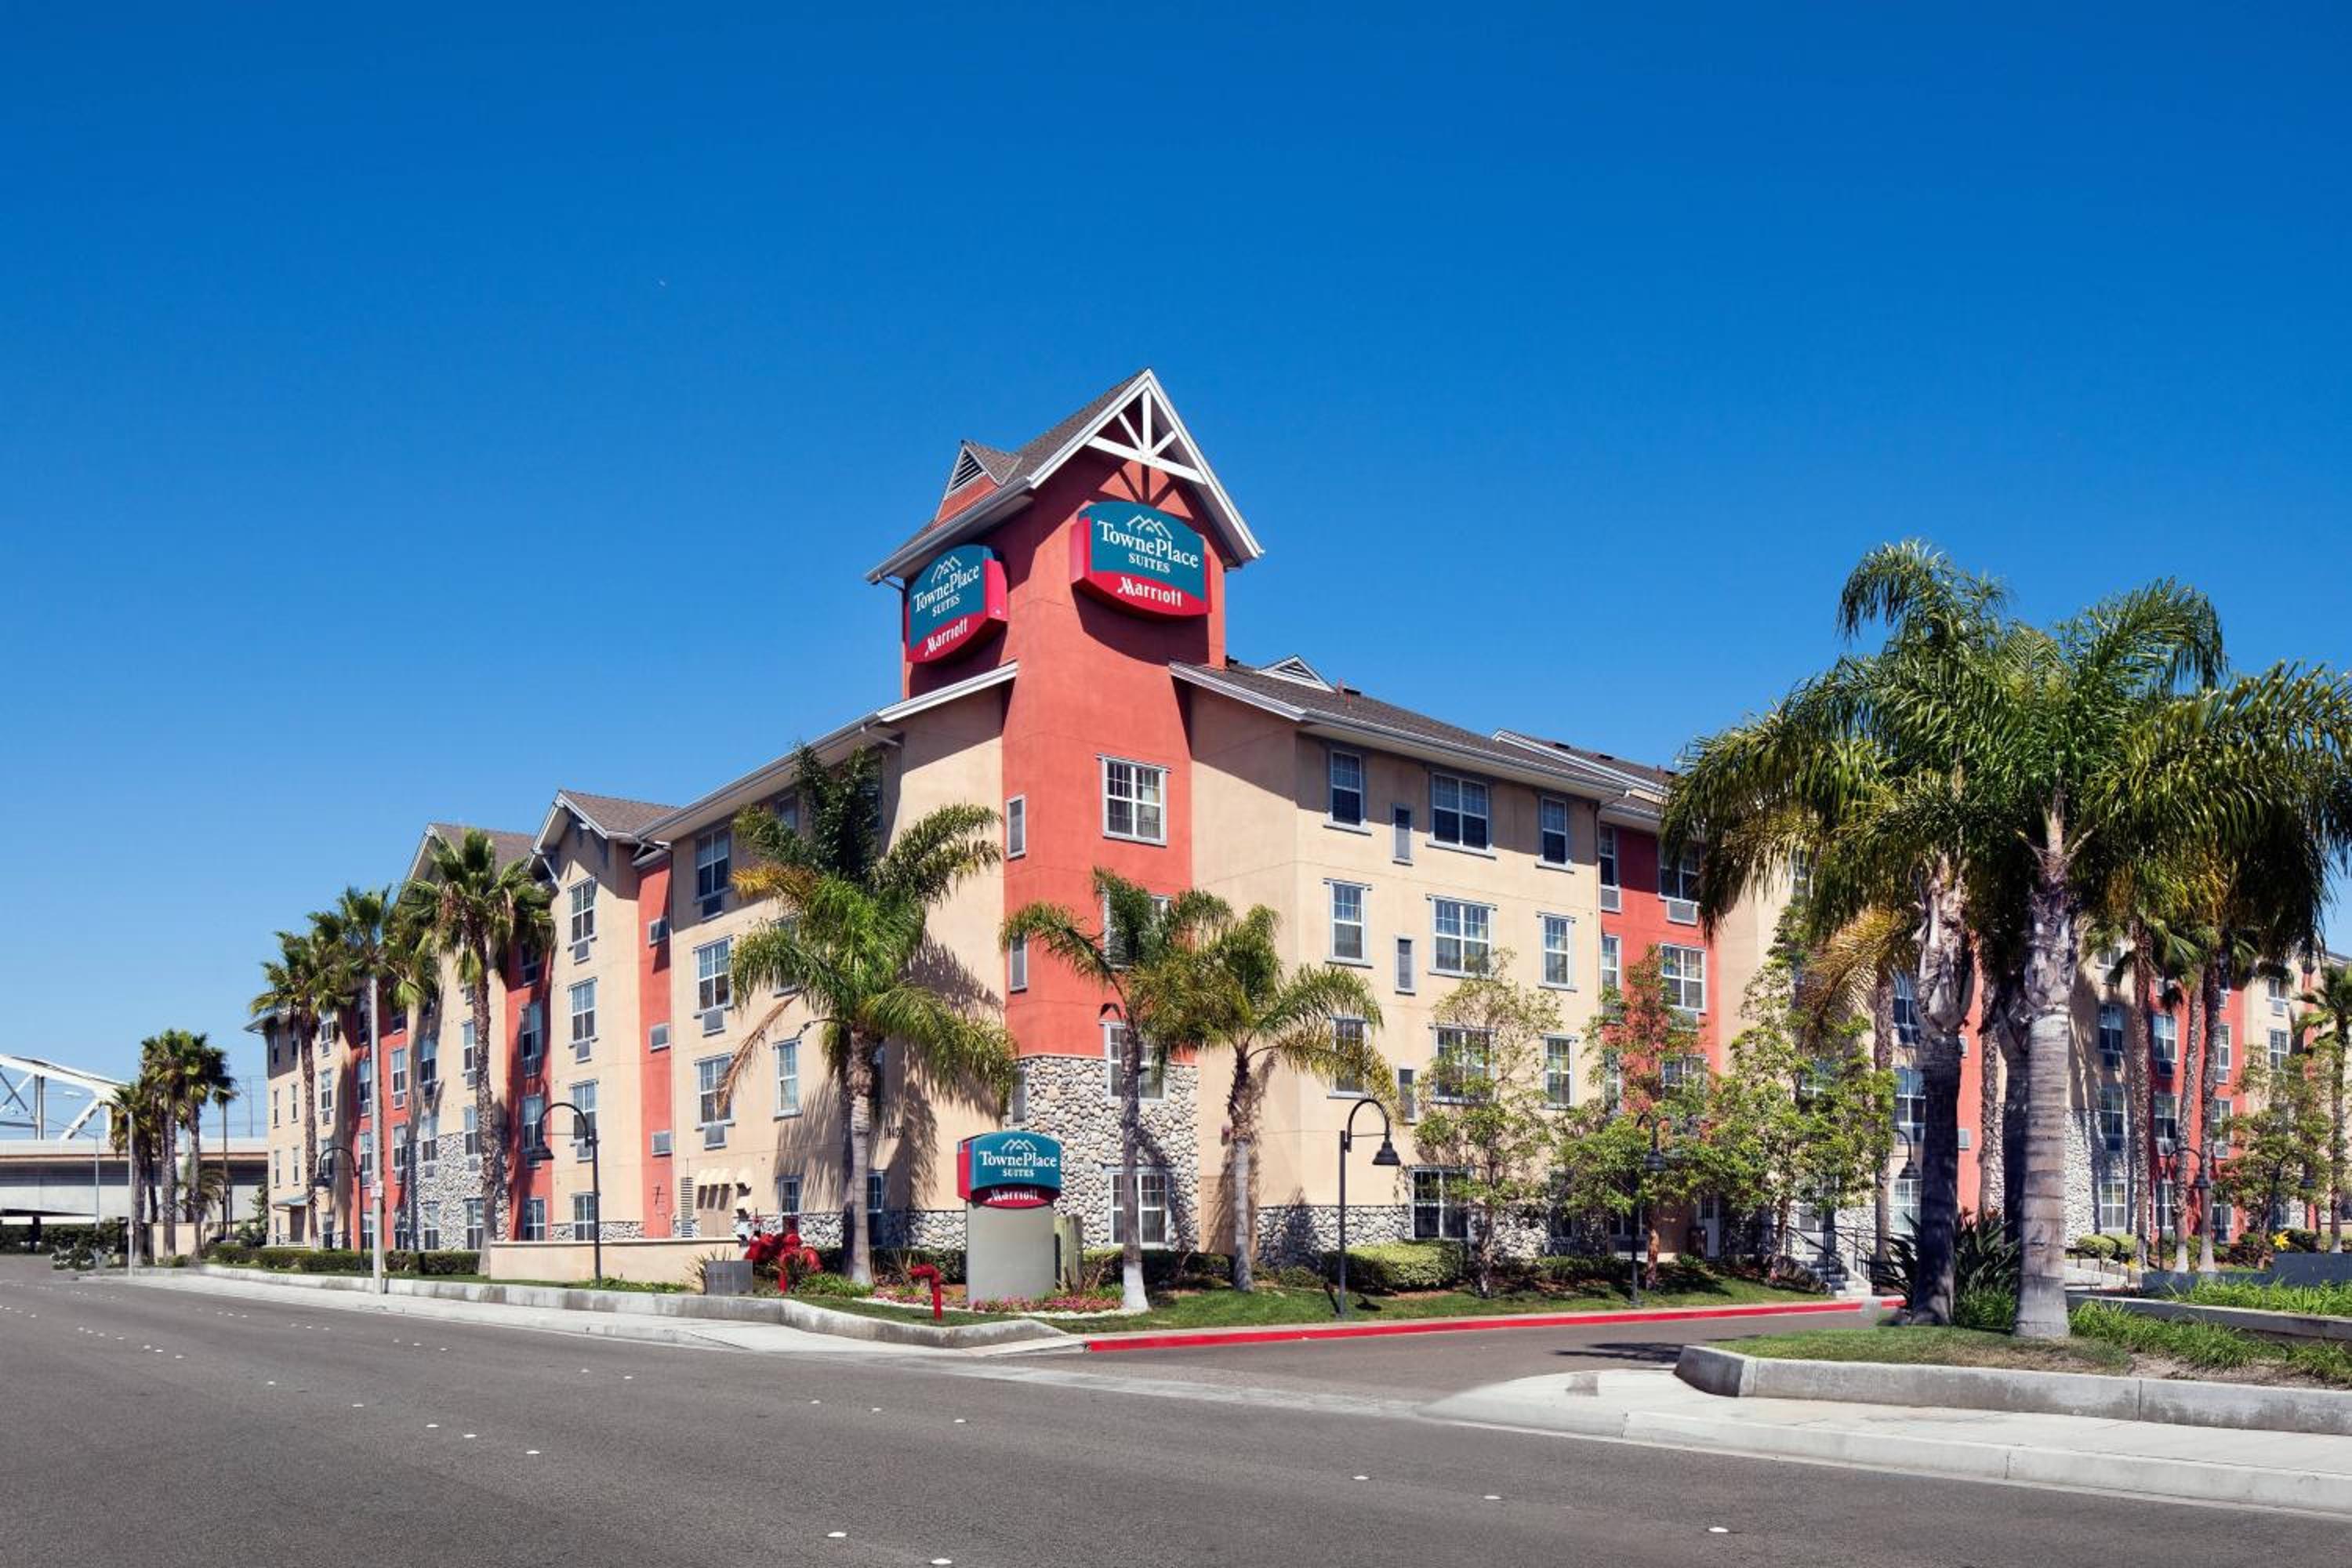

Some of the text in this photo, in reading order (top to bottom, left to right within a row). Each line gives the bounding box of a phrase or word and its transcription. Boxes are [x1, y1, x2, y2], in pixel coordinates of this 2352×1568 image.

[1098, 520, 1199, 568] TownePlace
[1128, 552, 1171, 574] SUITES
[913, 565, 979, 613] TownePlace
[1117, 576, 1181, 607] Marriott
[932, 593, 960, 617] SUITES
[924, 617, 967, 657] Marriott
[978, 1149, 1058, 1167] TownePlace
[1003, 1168, 1034, 1178] SUITES
[987, 1188, 1038, 1201] Marriott
